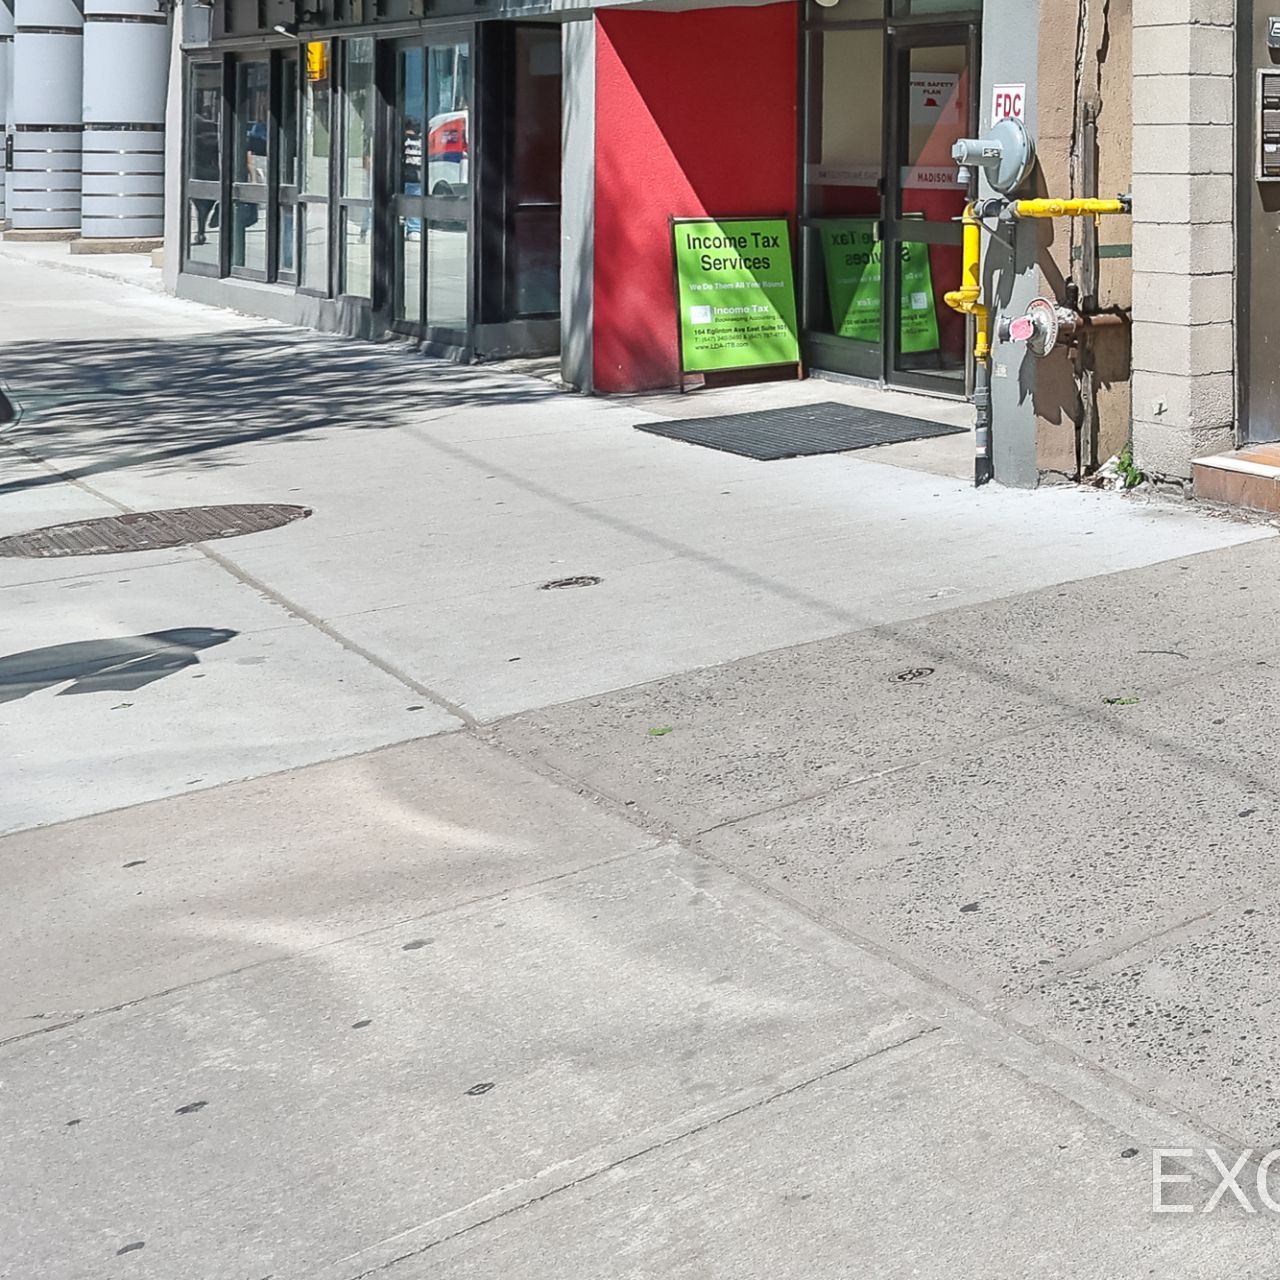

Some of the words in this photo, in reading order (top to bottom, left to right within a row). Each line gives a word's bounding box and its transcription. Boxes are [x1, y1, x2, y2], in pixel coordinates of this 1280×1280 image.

[995, 93, 1022, 118] FDC
[917, 172, 953, 184] MADISON
[687, 233, 748, 250] Income
[751, 232, 780, 248] Tax
[701, 254, 771, 271] Services
[689, 283, 702, 291] We
[703, 282, 713, 290] Do
[713, 306, 750, 315] Income
[752, 304, 769, 313] Tax
